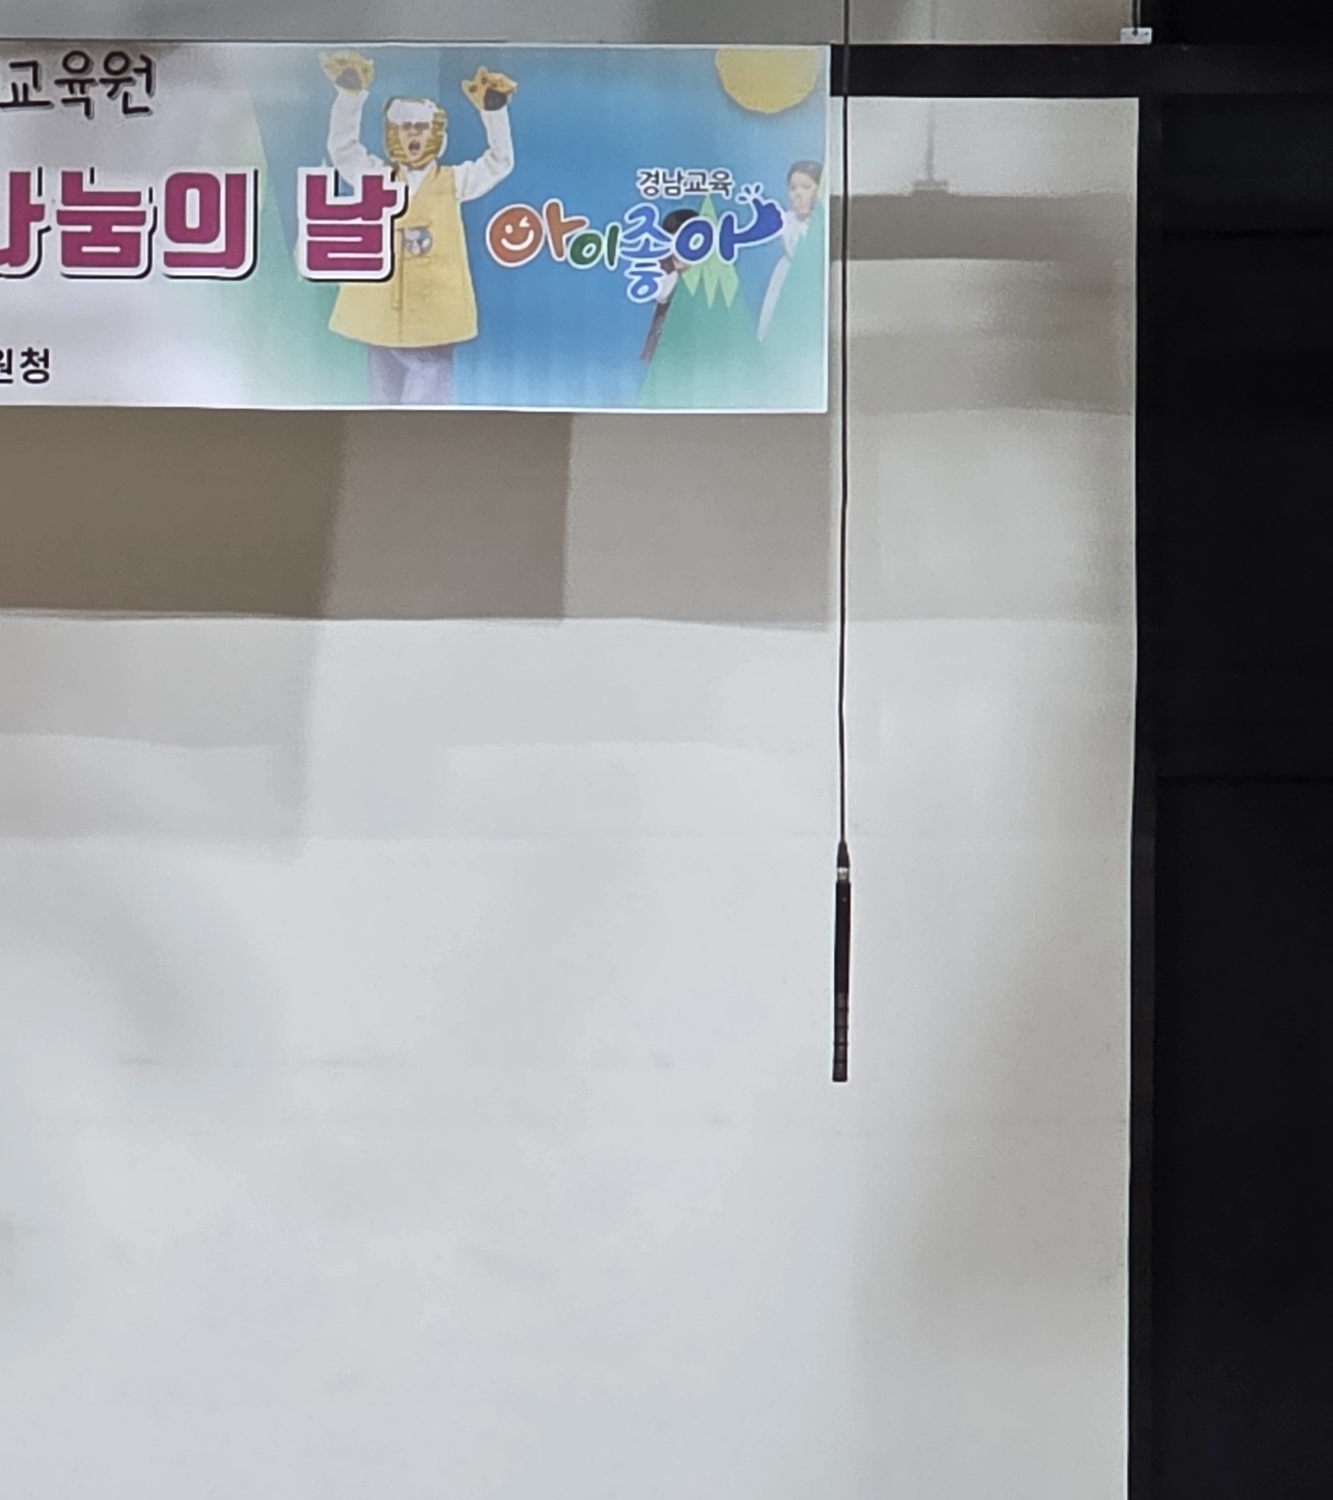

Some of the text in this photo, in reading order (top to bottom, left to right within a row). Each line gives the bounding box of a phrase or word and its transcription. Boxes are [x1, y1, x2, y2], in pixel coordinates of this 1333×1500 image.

[305, 169, 407, 281] 날
[638, 169, 733, 197] 경남교육
[487, 198, 784, 301] 아이좋아
